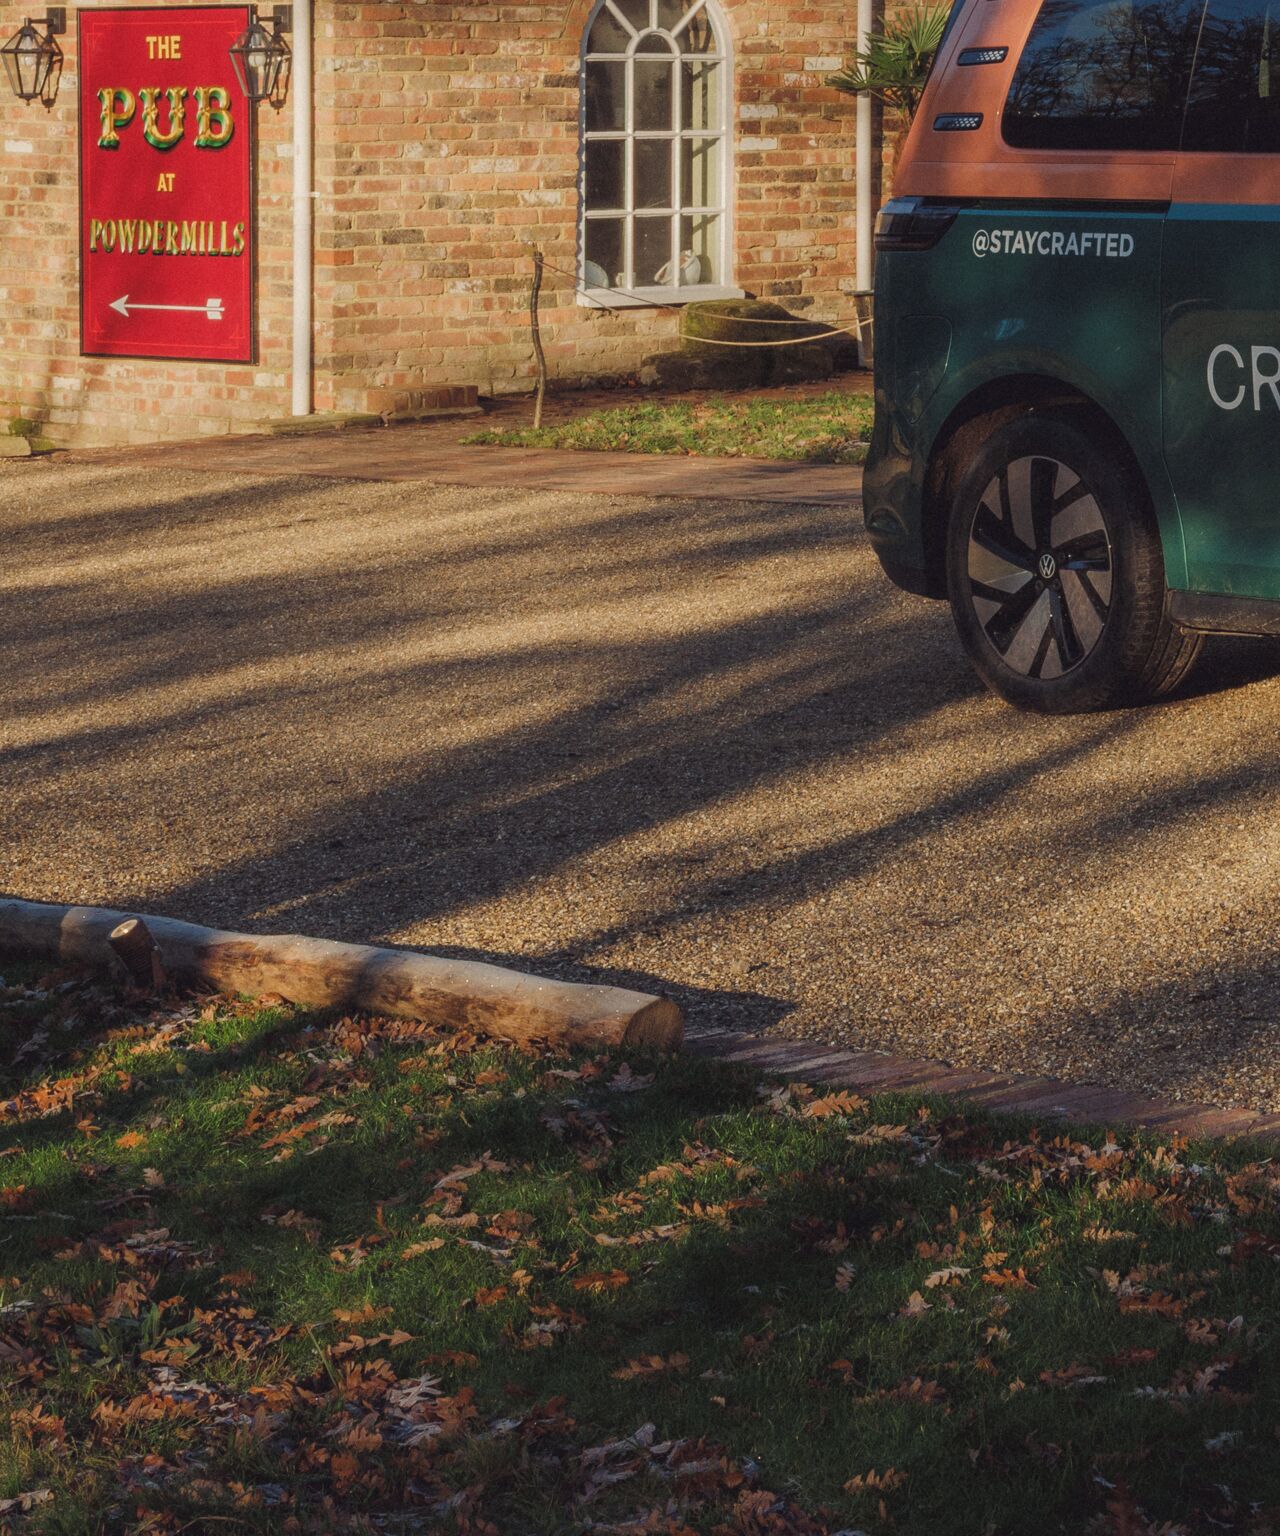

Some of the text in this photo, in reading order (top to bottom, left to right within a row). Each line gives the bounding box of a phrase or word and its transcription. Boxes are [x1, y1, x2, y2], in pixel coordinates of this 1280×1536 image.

[146, 35, 181, 60] THE
[97, 86, 235, 150] PUB
[157, 173, 175, 192] AT
[90, 219, 245, 256] POWDERMILLS
[972, 229, 1134, 257] @STAYCRAFTED
